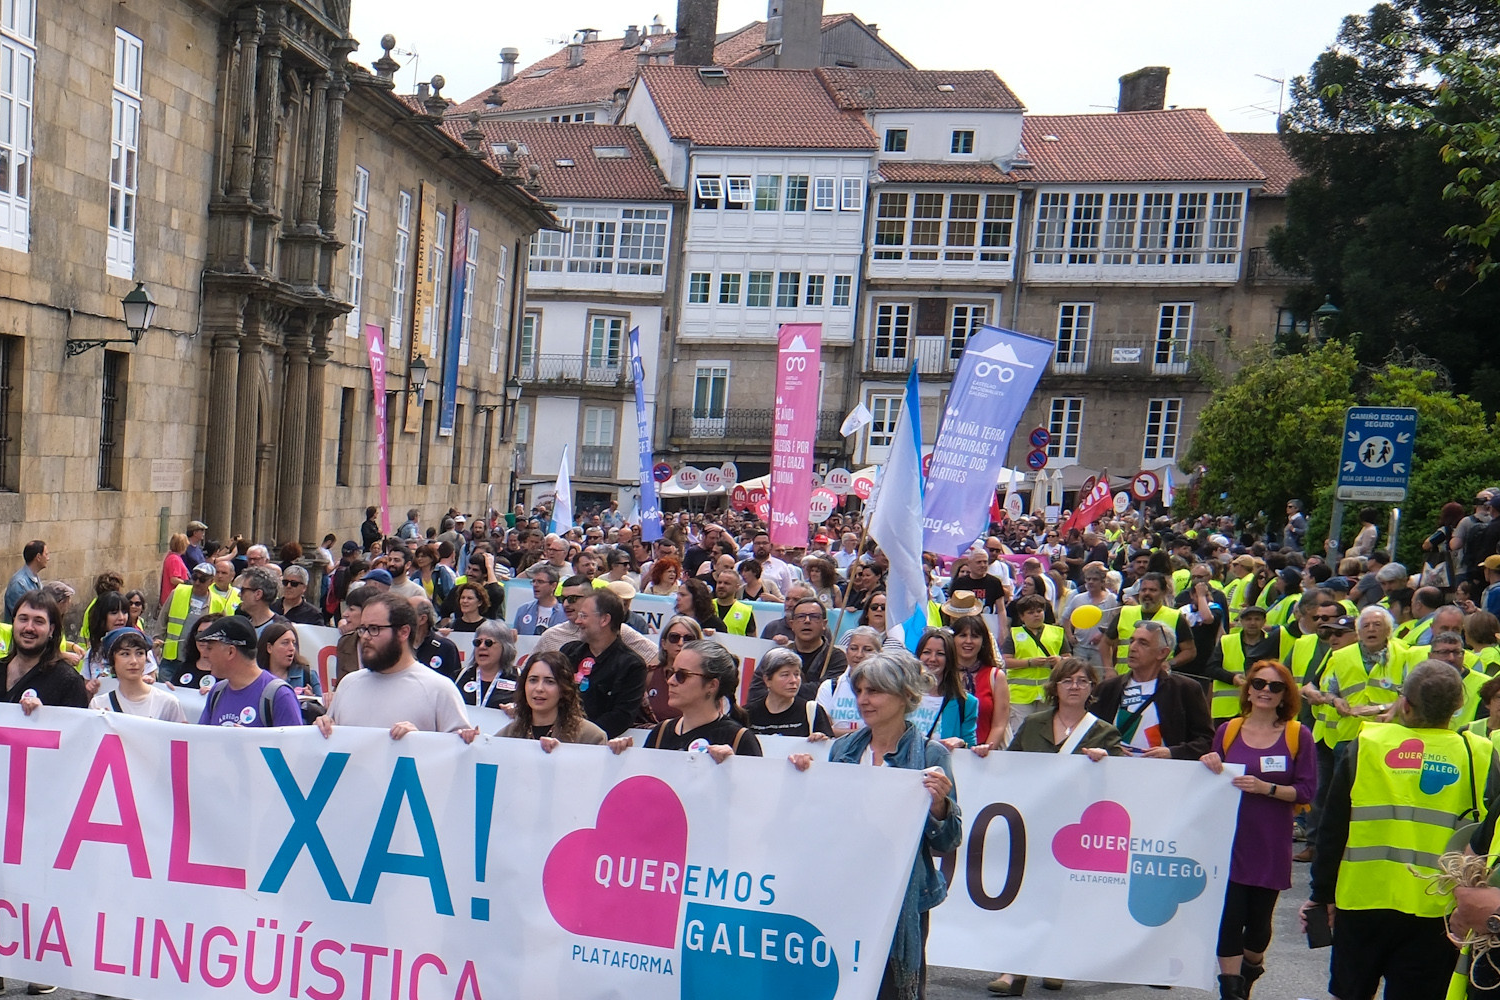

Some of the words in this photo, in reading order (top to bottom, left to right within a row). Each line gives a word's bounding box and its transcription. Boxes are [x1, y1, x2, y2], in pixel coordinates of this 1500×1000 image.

[956, 421, 978, 437] MIÑA
[981, 426, 1006, 442] TERRA
[797, 441, 810, 454] POR
[990, 445, 998, 457] A
[969, 456, 988, 472] DOS
[680, 472, 696, 481] CIG
[705, 473, 720, 482] CIG
[831, 474, 848, 484] CIG
[810, 502, 827, 512] CIG
[1398, 751, 1447, 762] QUEREMOS
[1423, 763, 1459, 775] GALEGO
[1080, 834, 1177, 854] QUEREMOS
[594, 854, 776, 906] QUEREMOS
[1069, 873, 1126, 885] PLATAFORMA
[572, 944, 674, 976] PLATAFORMA
